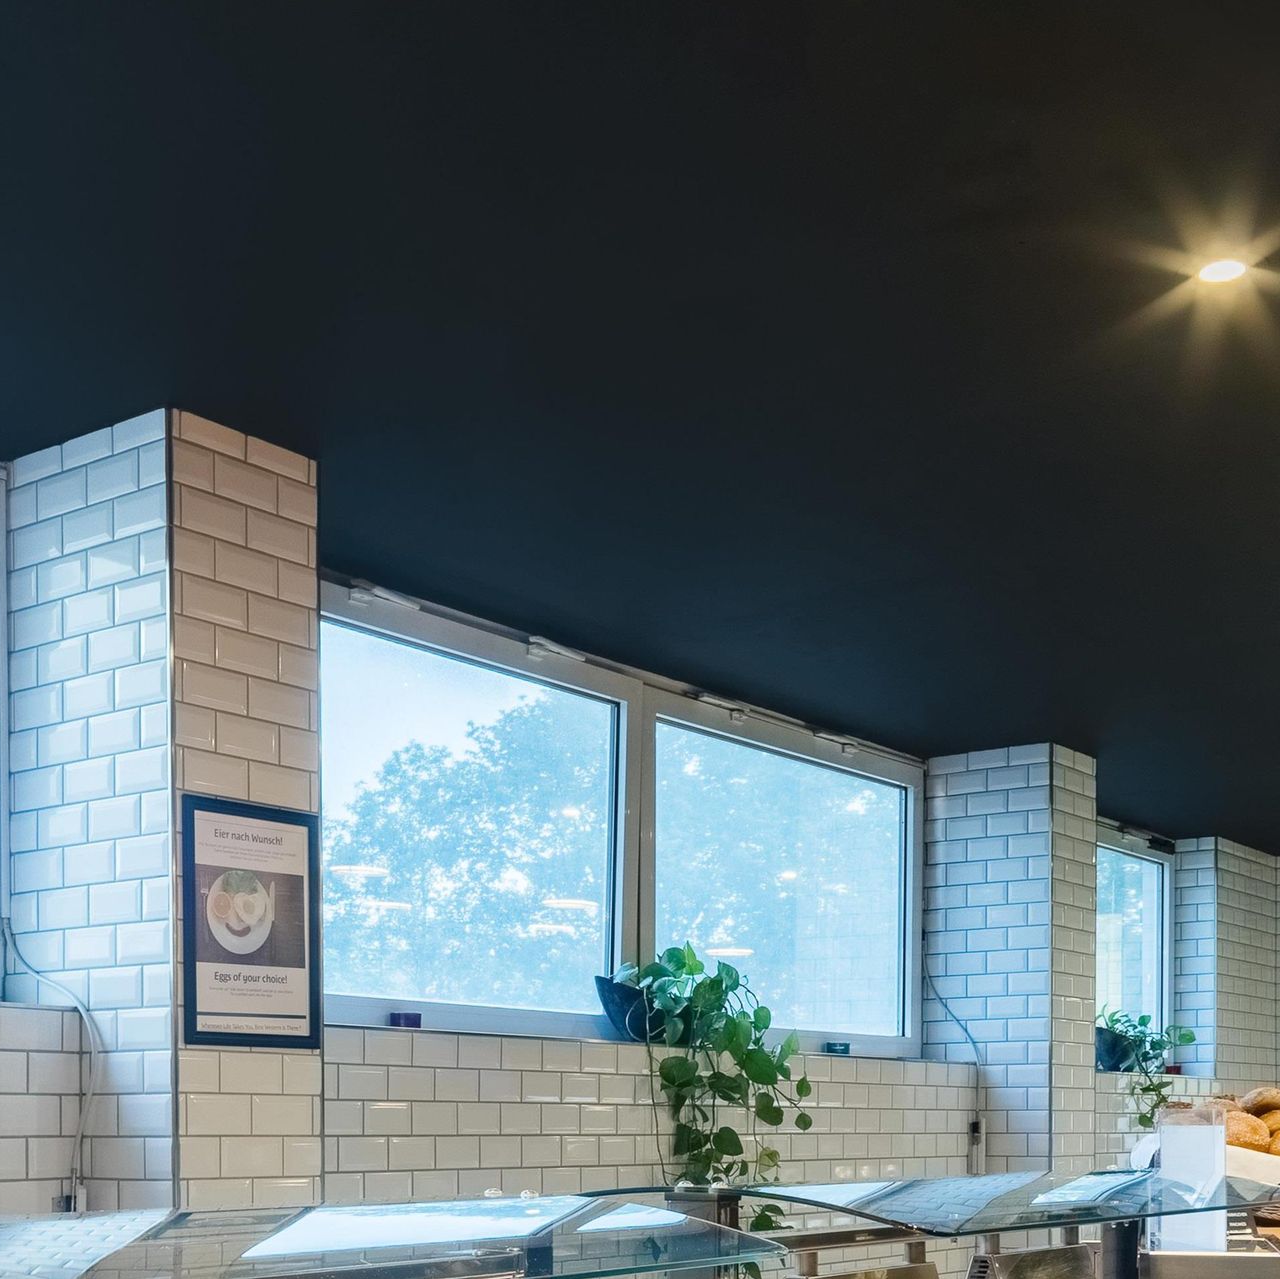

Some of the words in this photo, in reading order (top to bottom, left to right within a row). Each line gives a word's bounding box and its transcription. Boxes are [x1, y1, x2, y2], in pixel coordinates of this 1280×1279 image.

[214, 828, 229, 839] Eier
[231, 832, 249, 842] nach
[251, 834, 283, 846] Wunsch!
[214, 971, 231, 983] Eggs
[233, 972, 242, 982] of
[243, 974, 261, 984] your
[262, 973, 288, 984] choice!
